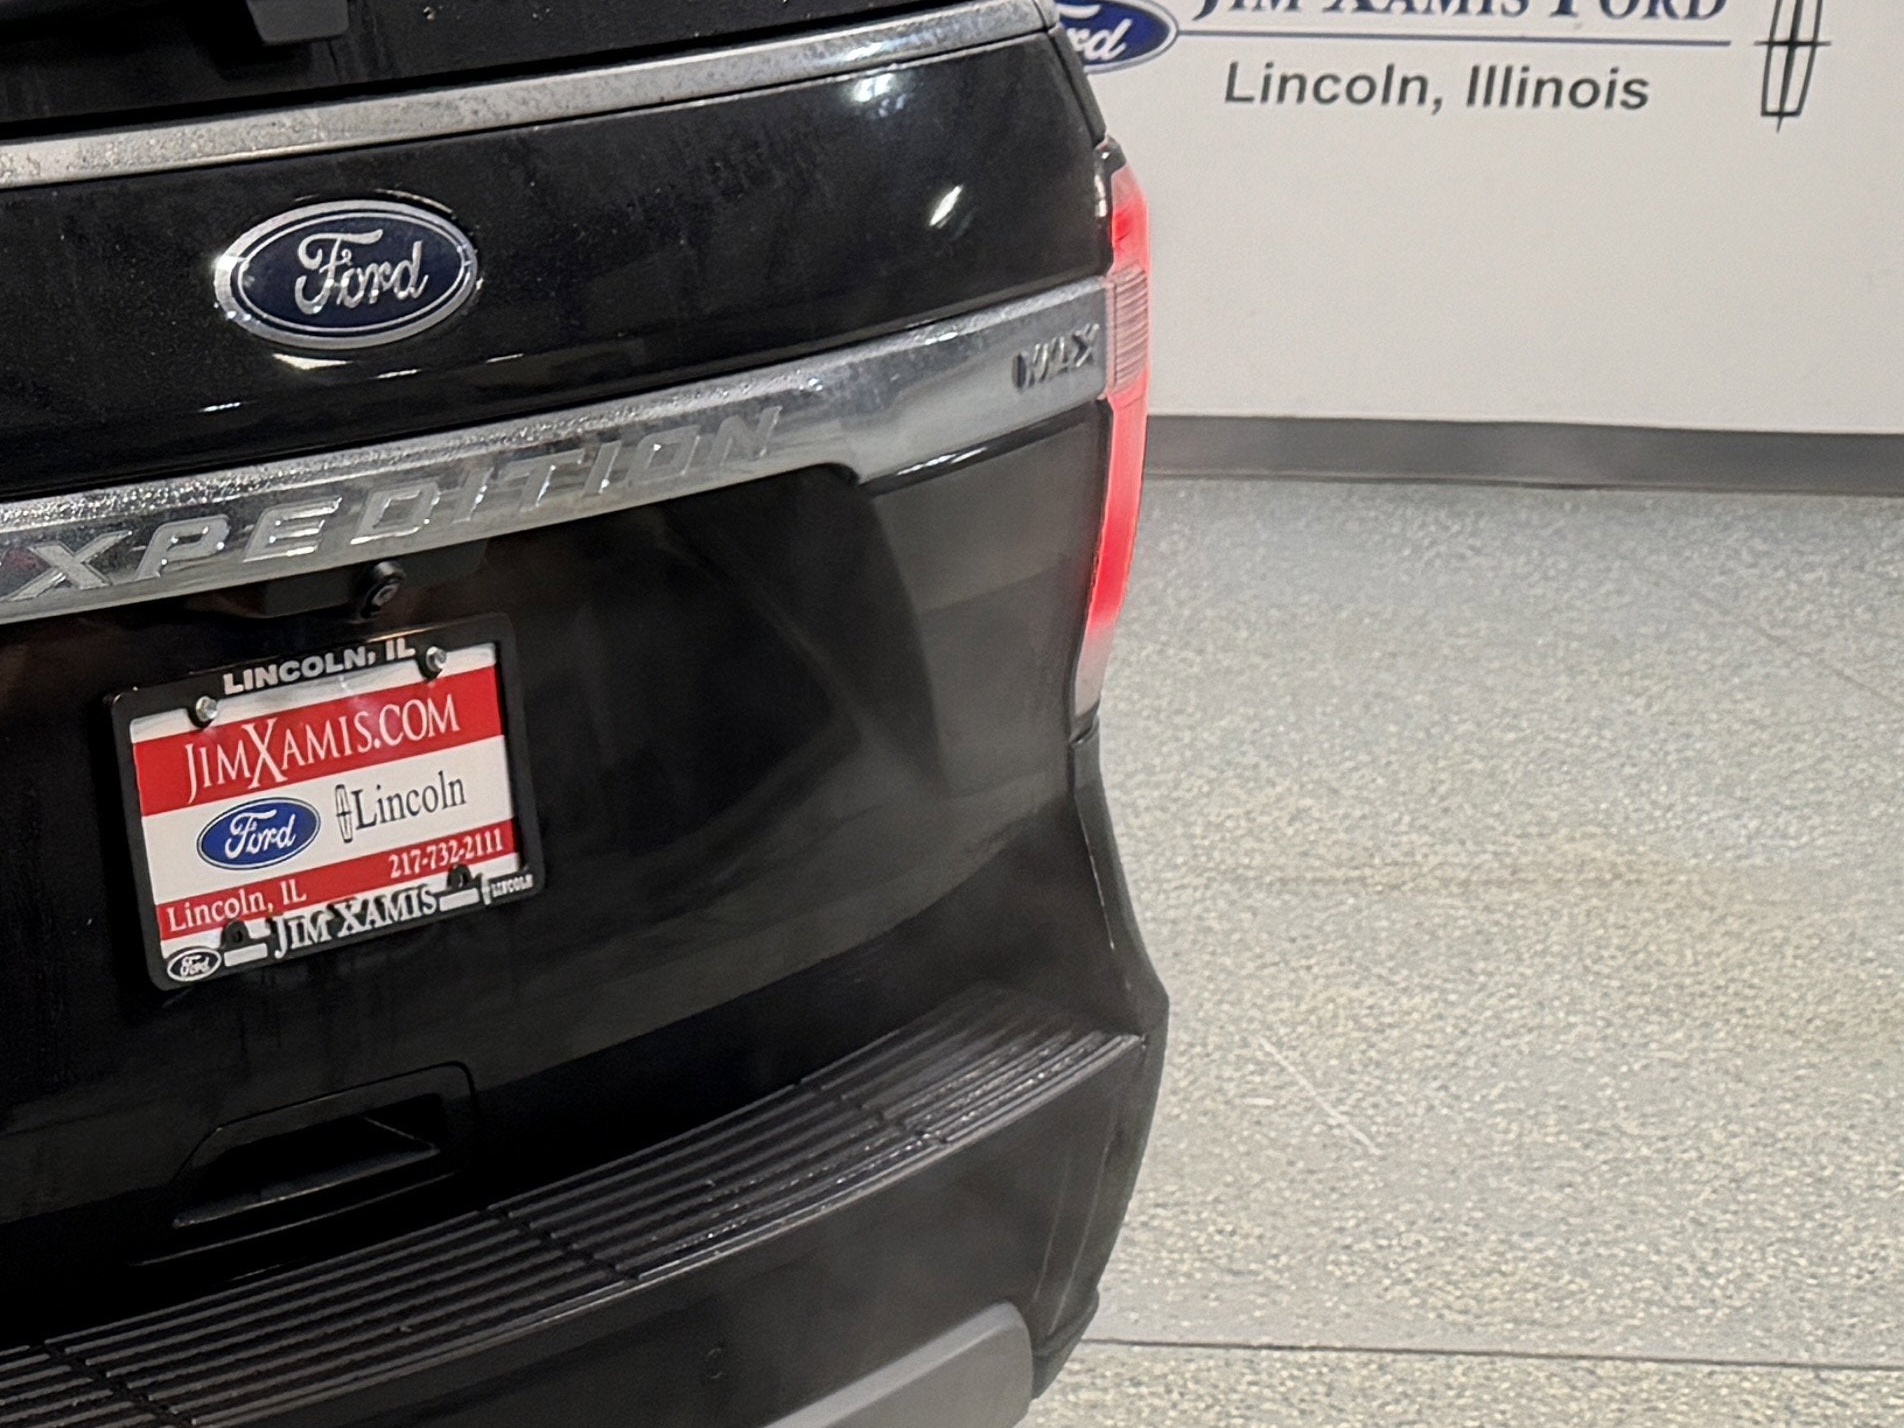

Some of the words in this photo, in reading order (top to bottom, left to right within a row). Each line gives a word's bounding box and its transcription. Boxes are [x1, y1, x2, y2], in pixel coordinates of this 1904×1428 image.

[1224, 61, 1443, 116] Lincoln,
[1466, 64, 1650, 111] Illinois
[294, 228, 430, 316] Ford
[223, 644, 376, 696] LINCOLN,
[385, 638, 416, 660] IL
[183, 693, 460, 804] JIMXAMIS.COM
[223, 809, 298, 860] Ford
[352, 770, 467, 831] Lincoln
[387, 827, 505, 880] 217-732-2111
[166, 888, 274, 932] Lincoln,
[279, 878, 308, 906] IL
[272, 912, 332, 960] JIM
[336, 886, 437, 938] XAMIS
